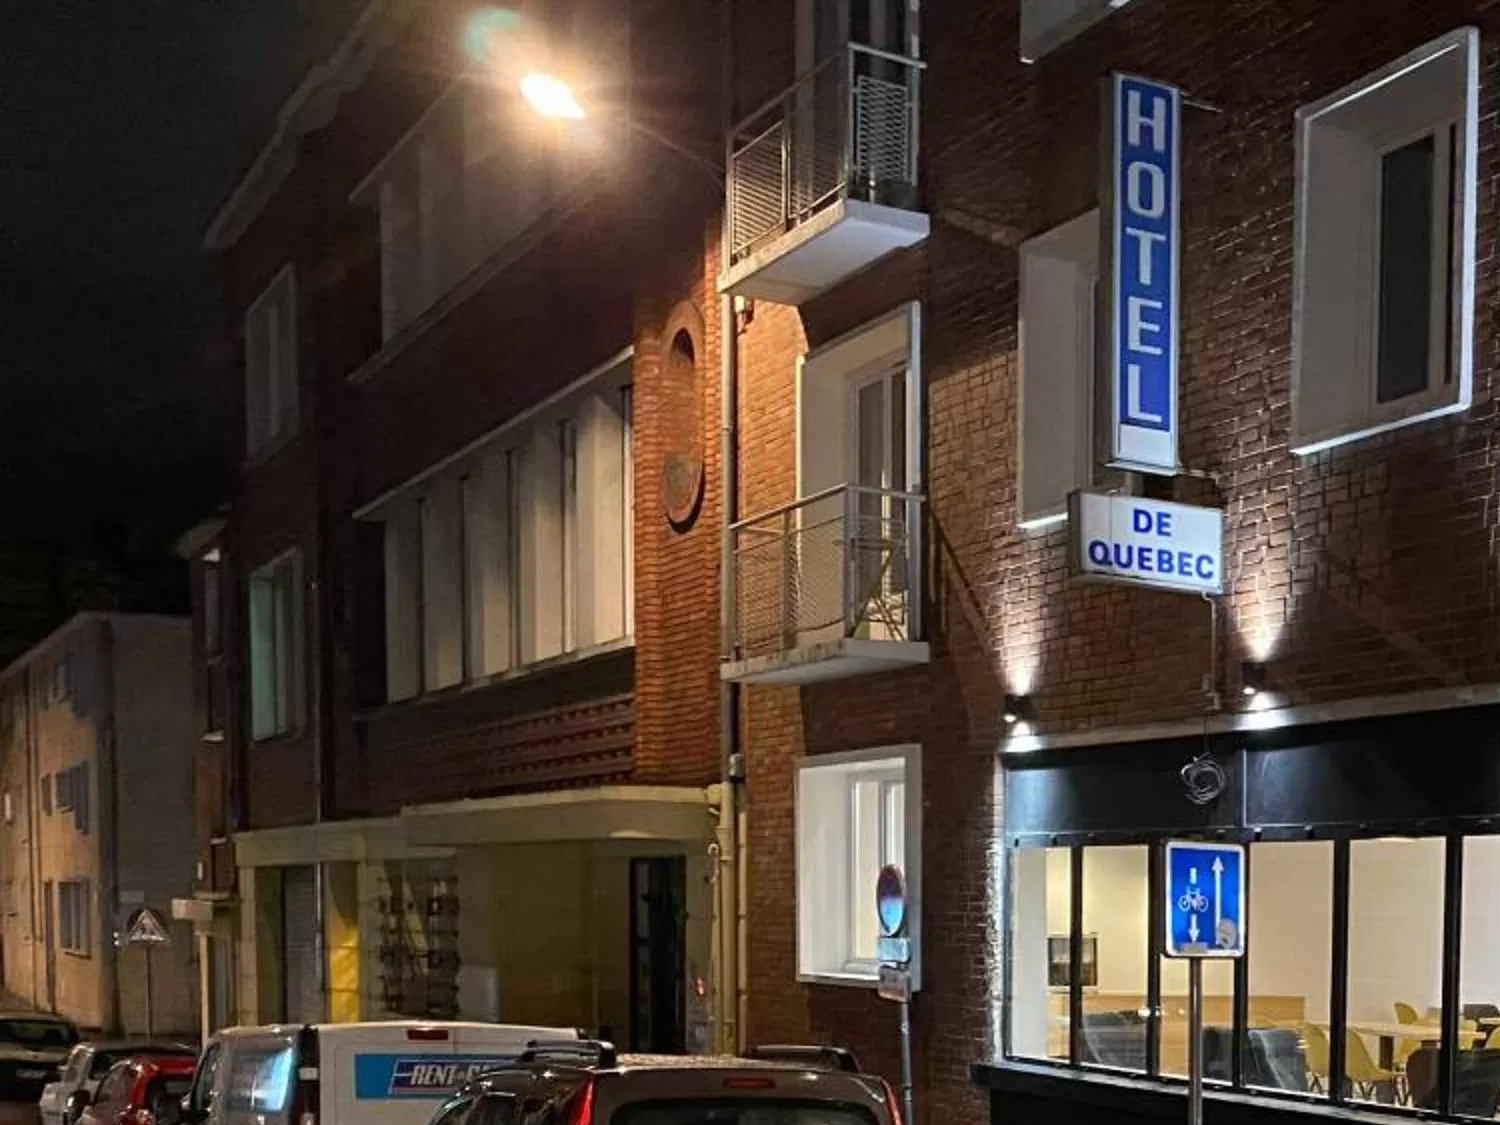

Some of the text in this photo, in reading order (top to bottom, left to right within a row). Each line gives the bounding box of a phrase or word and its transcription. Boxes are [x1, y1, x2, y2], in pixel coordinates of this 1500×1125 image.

[1126, 90, 1165, 423] HOTEL
[1133, 508, 1172, 537] DE
[1088, 541, 1215, 580] QUEBEC
